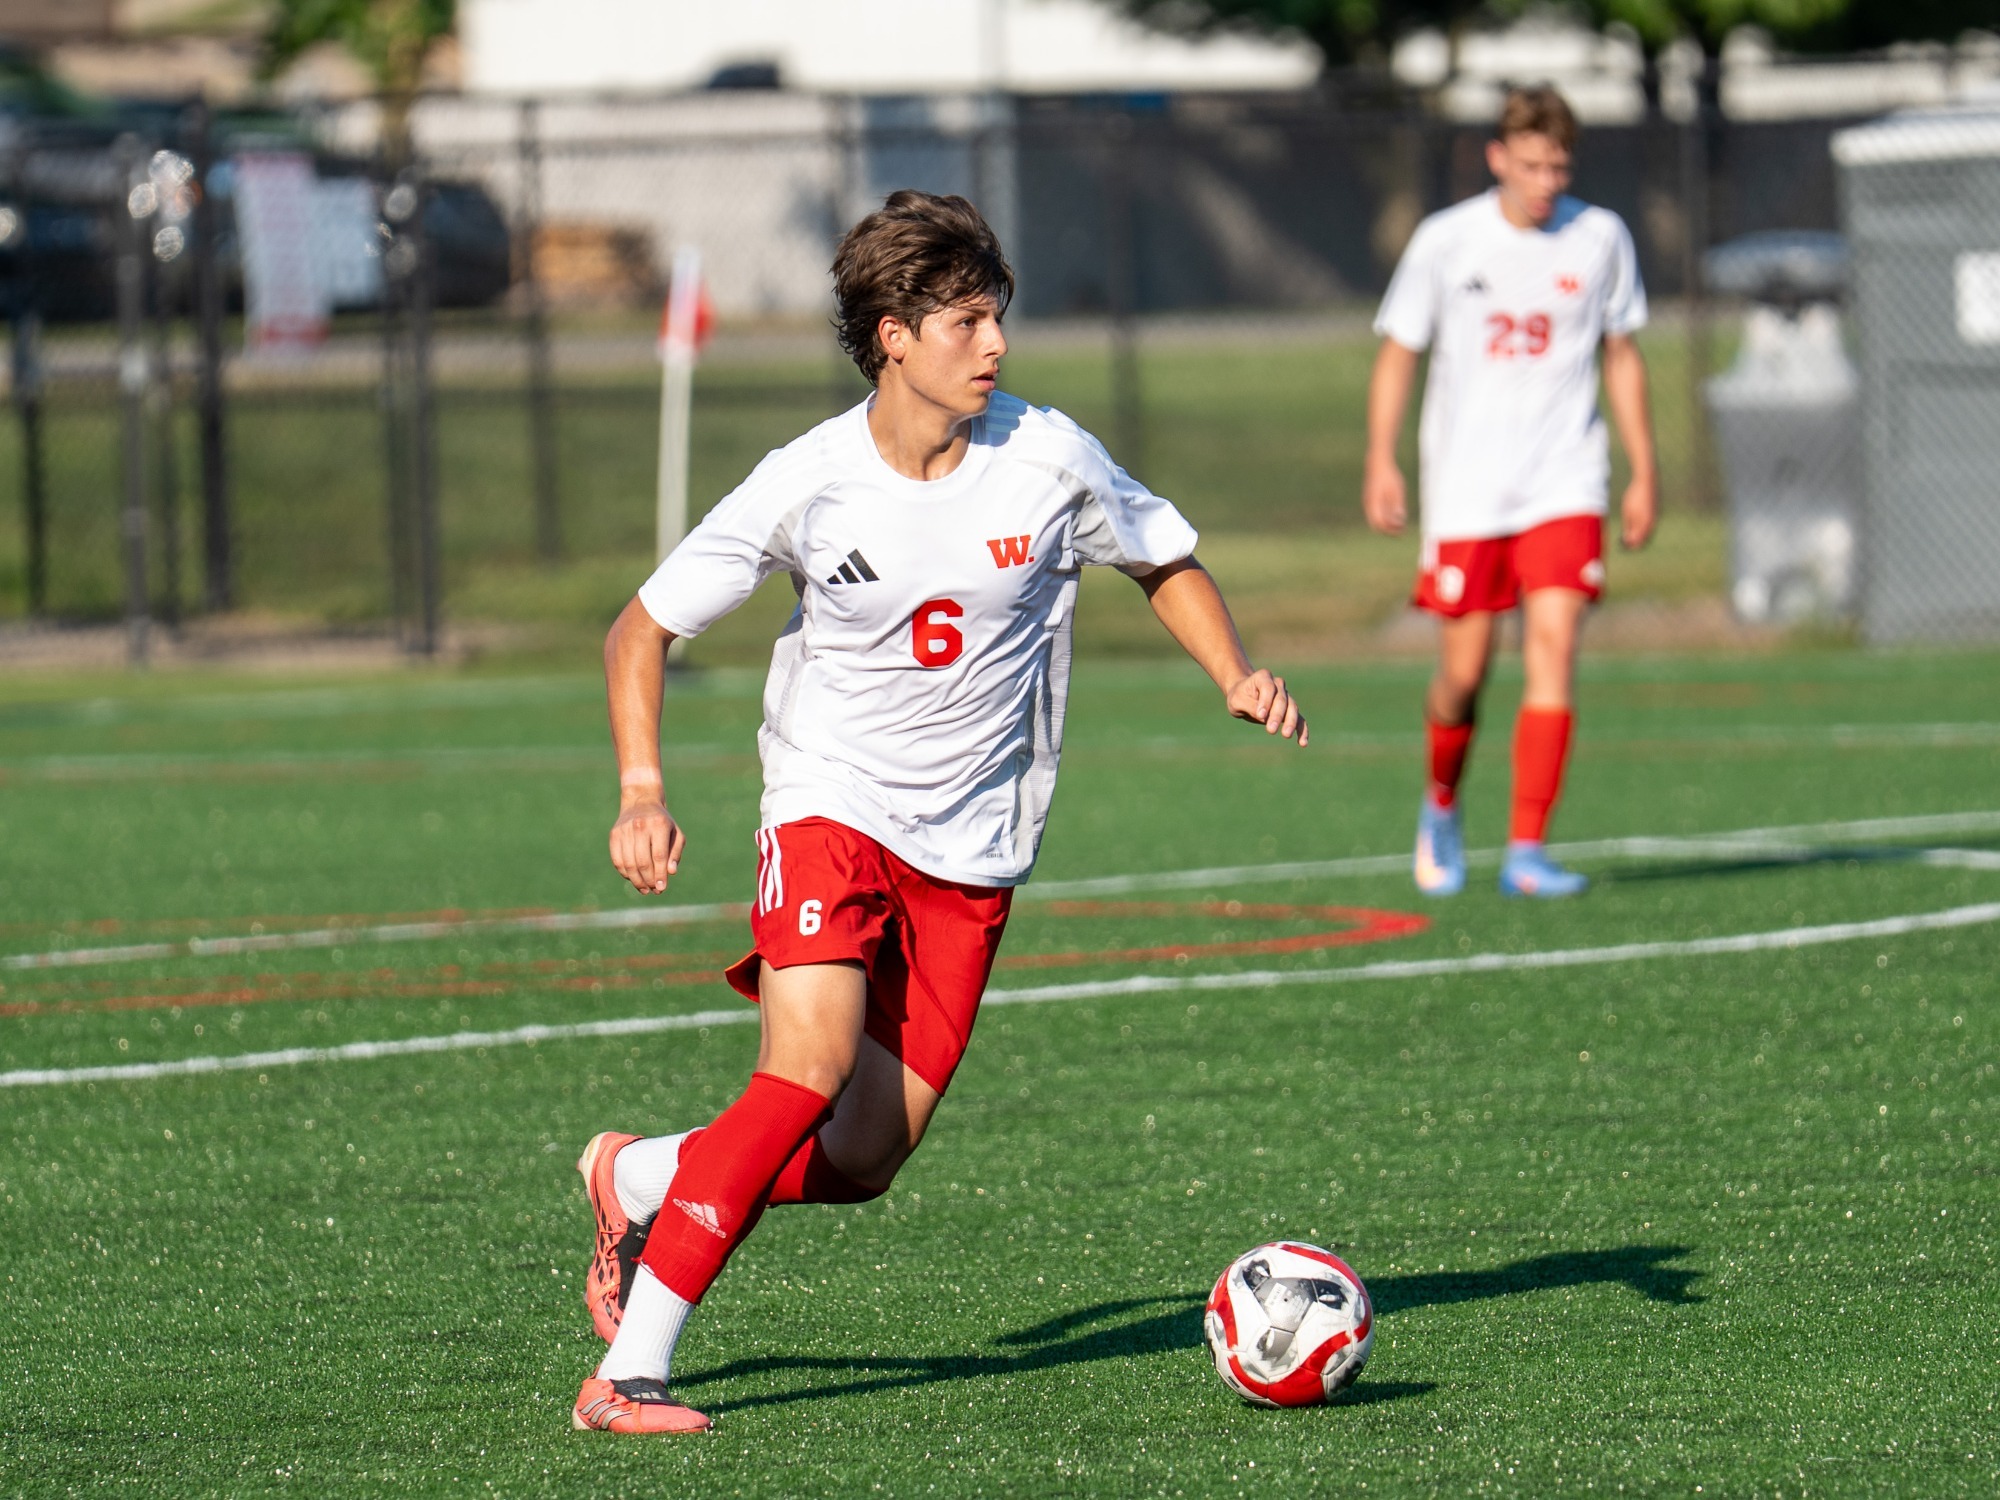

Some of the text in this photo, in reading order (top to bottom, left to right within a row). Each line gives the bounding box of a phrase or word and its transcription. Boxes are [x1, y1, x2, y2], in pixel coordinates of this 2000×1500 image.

[1486, 312, 1552, 358] 29
[912, 598, 963, 667] 6
[799, 899, 822, 936] 6
[673, 1198, 727, 1239] adidas
